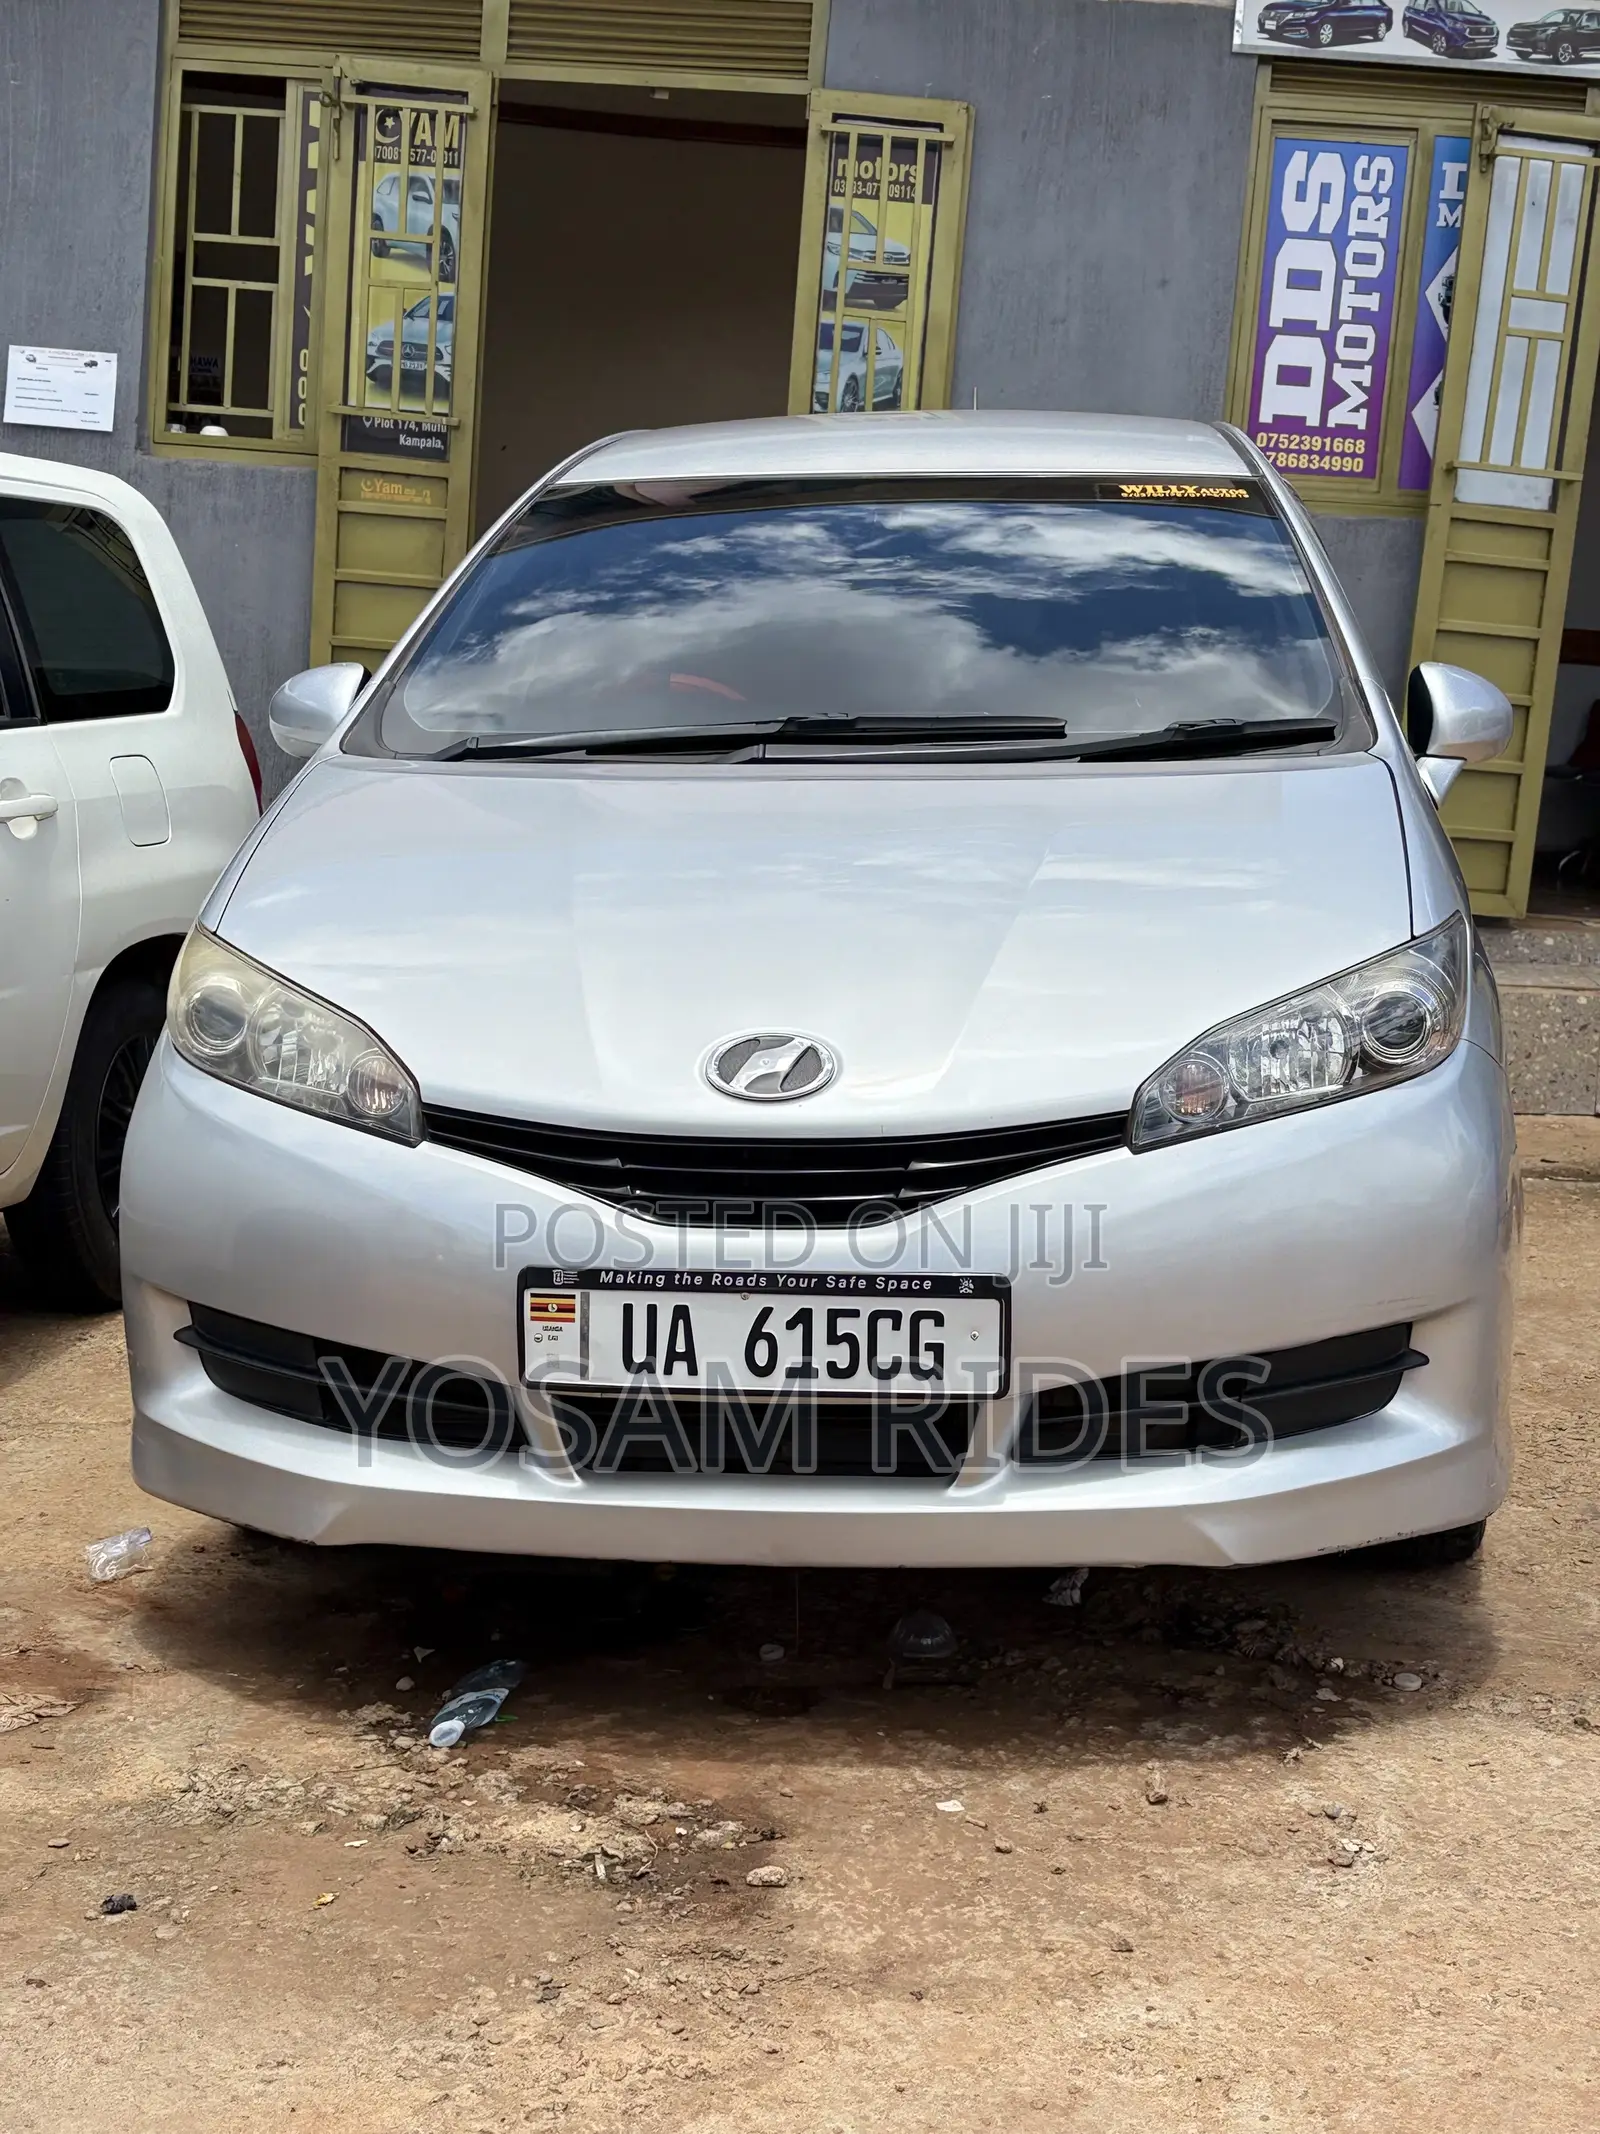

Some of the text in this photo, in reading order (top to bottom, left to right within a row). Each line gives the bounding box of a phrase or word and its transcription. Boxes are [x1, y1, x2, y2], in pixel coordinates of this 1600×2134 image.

[1259, 150, 1346, 427] DDS
[1327, 154, 1394, 430] MOTORS
[1256, 432, 1366, 455] 0752391668
[1265, 451, 1364, 473] 786834990
[600, 1270, 933, 1292] Making the Roads Your Safe Space
[622, 1303, 945, 1381] UA 615CG
